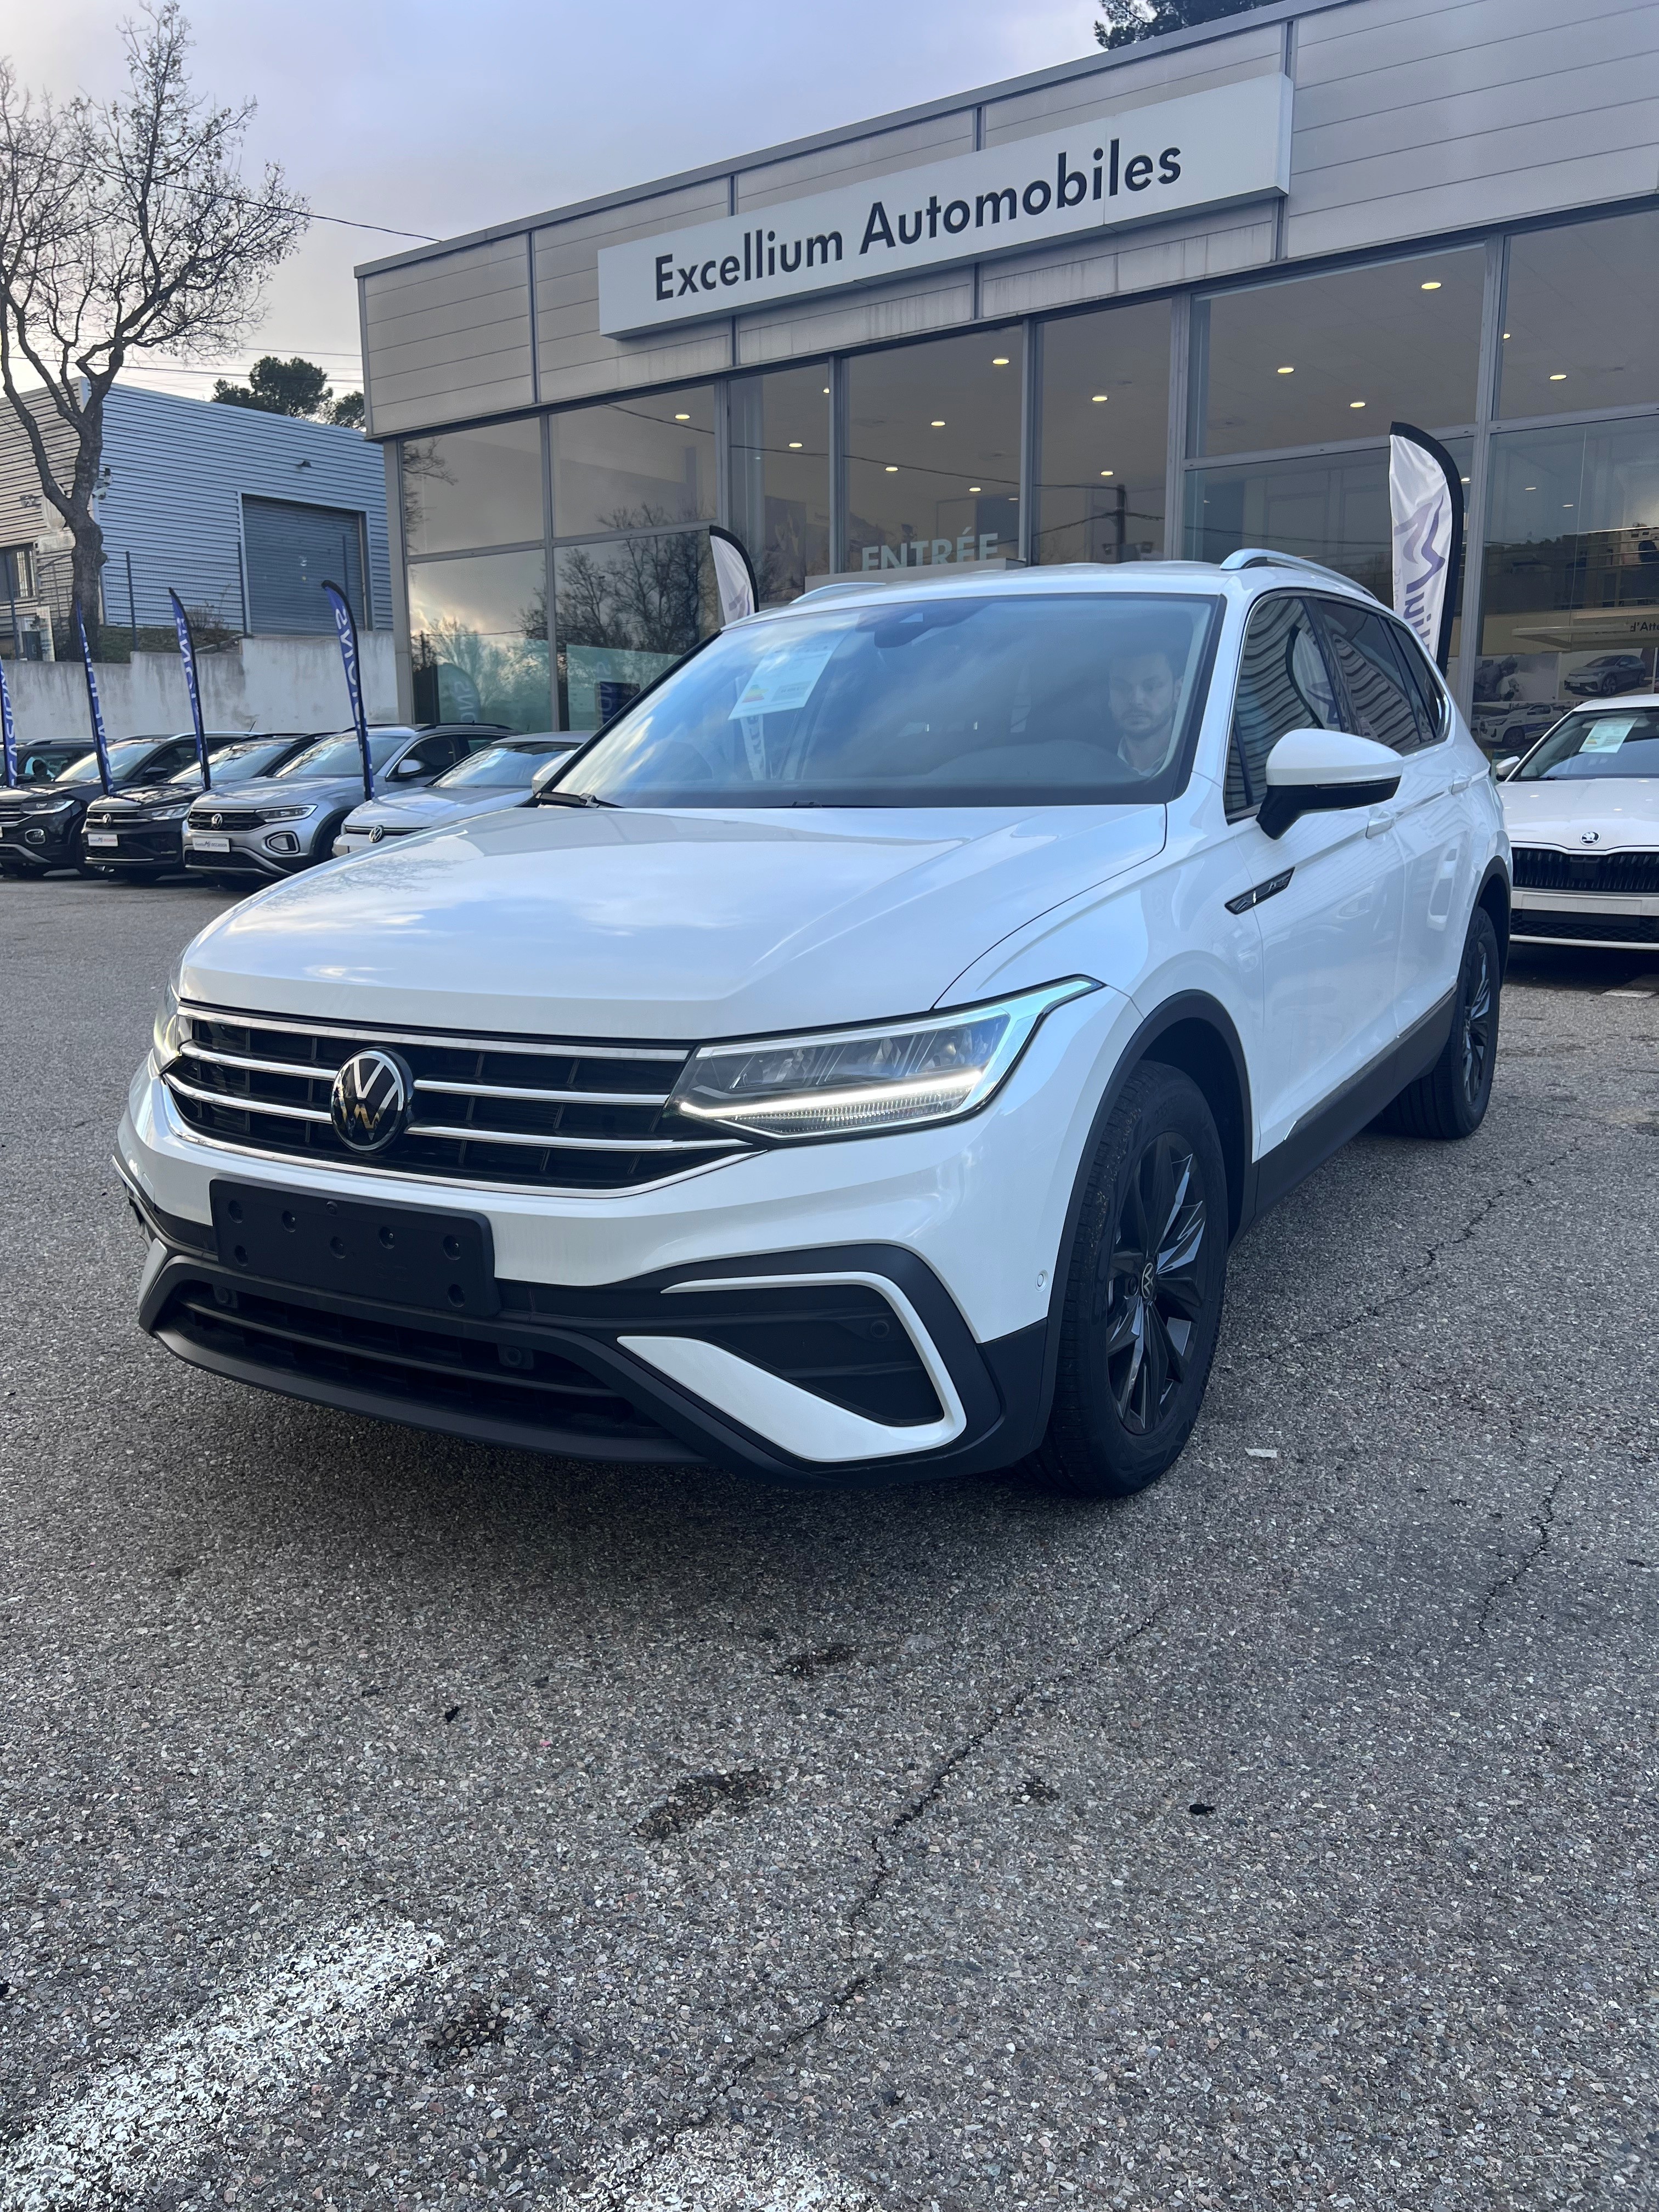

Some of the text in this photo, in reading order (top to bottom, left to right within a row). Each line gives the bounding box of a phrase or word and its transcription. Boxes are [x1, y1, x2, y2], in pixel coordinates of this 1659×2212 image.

[656, 138, 1181, 301] Excellium Automobiles
[862, 526, 998, 572] ENTRÉE
